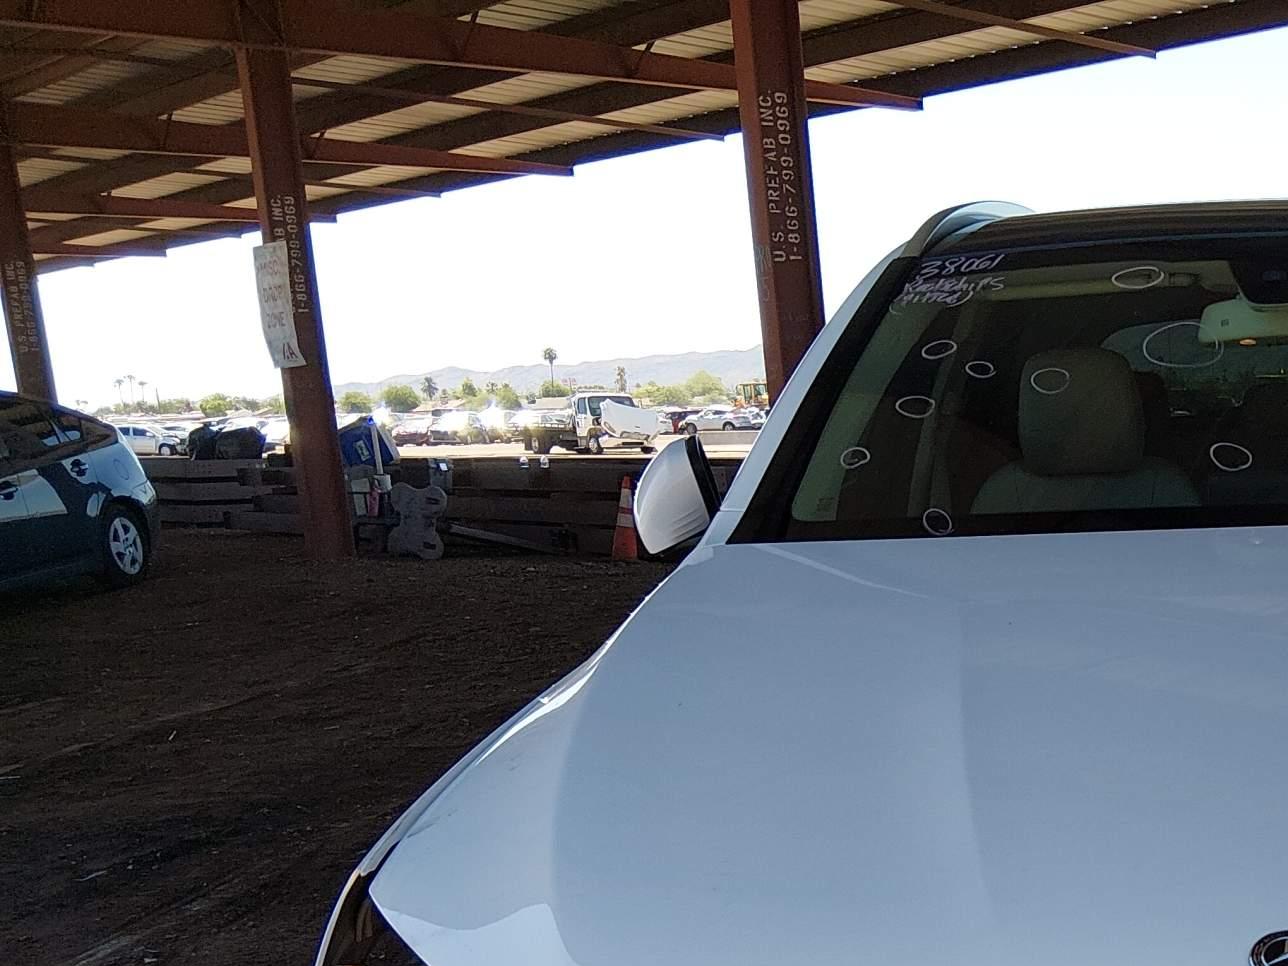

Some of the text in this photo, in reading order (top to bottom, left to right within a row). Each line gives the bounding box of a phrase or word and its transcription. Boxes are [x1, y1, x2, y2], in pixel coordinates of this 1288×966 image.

[271, 195, 284, 220] INC.
[759, 90, 787, 262] U.S. PREFAB INC.
[774, 91, 802, 260] 1-866-799-0969
[284, 196, 309, 313] 1-866-799-0969
